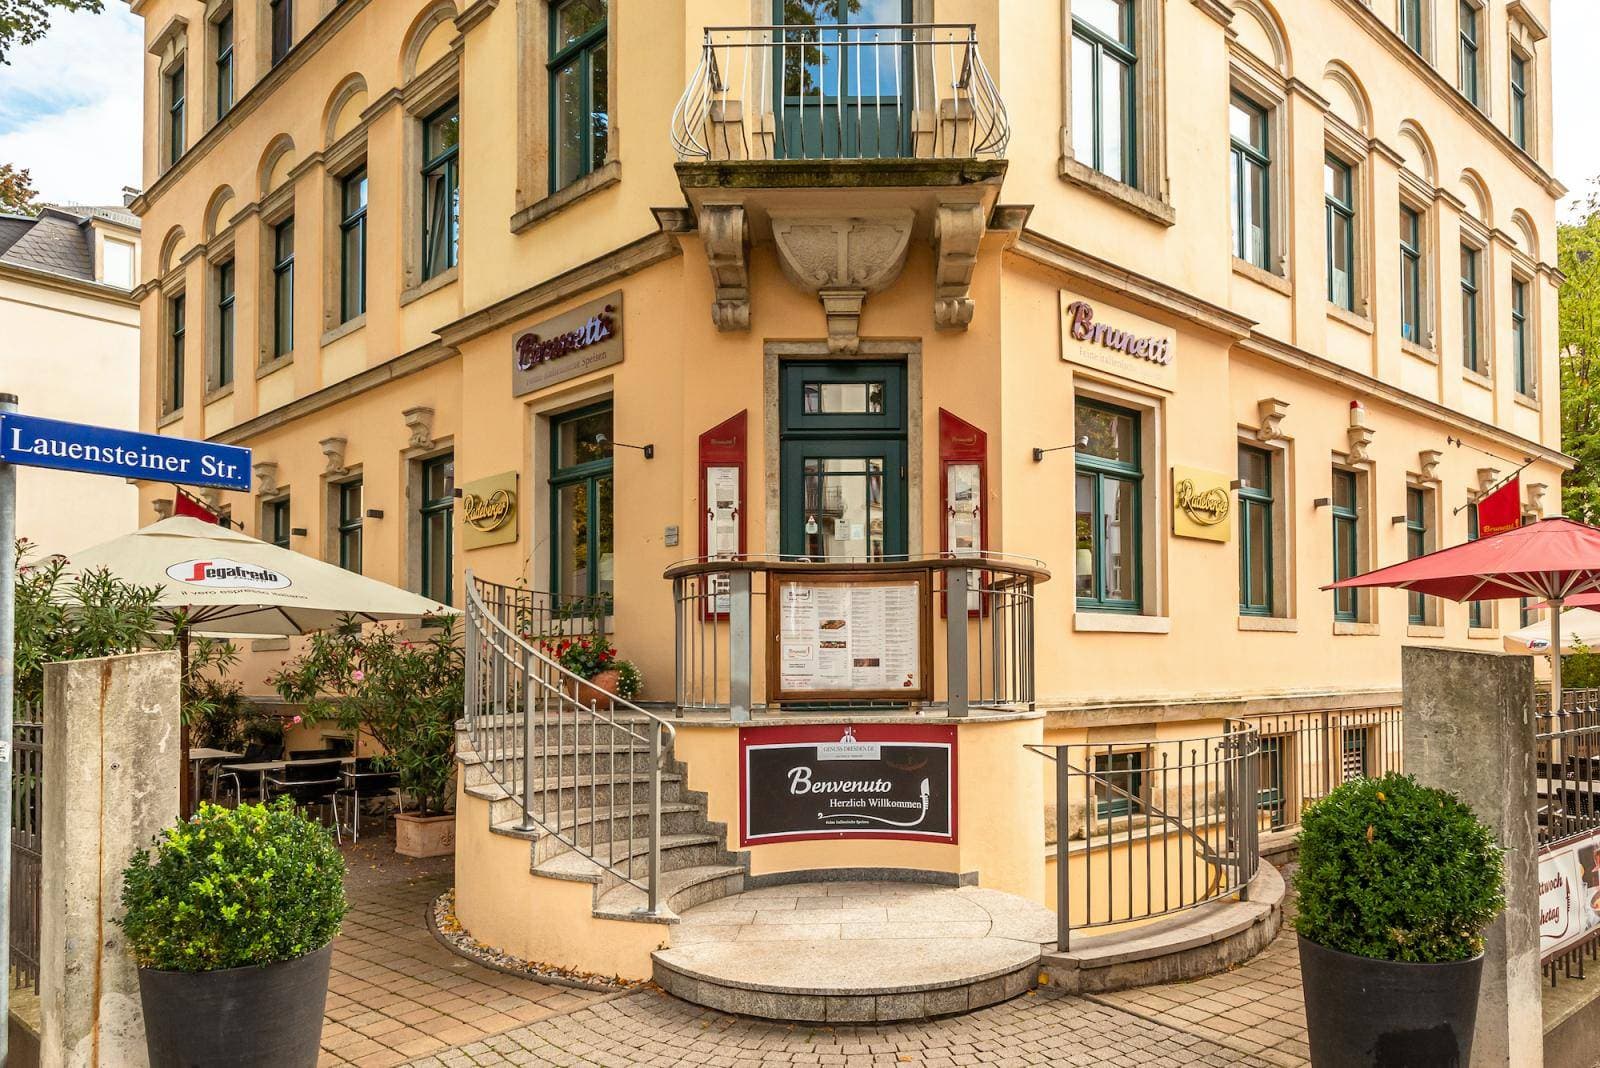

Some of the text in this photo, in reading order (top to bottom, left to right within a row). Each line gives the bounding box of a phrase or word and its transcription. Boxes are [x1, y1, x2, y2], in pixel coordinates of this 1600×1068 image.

[1068, 301, 1172, 365] Brunetti
[10, 427, 242, 480] Lauensteiner Str.
[185, 562, 278, 582] Segafredo
[787, 766, 892, 795] Benvenuto
[829, 799, 922, 809] Herzlich Willkommen
[1539, 906, 1560, 926] hetag
